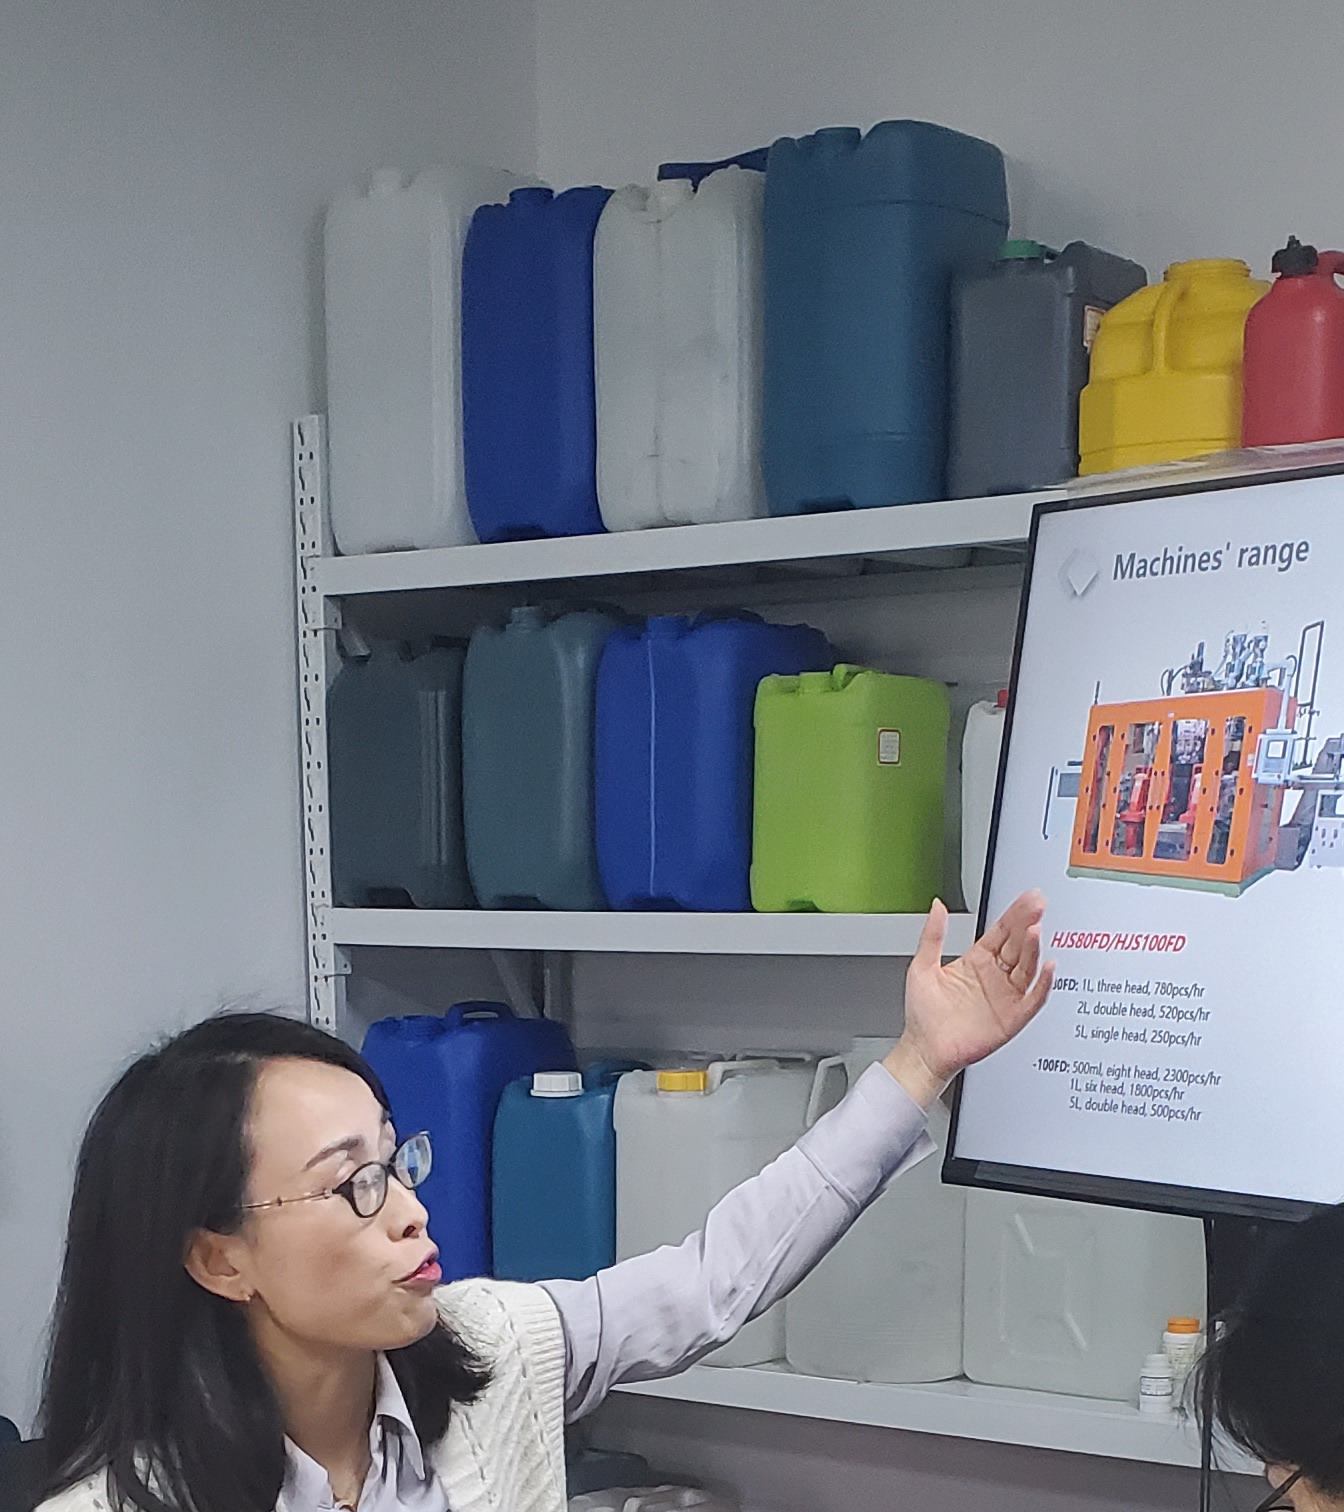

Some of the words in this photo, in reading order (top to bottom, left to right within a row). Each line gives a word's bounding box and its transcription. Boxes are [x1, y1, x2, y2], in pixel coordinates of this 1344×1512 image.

[1112, 542, 1230, 580] Machines'
[1237, 540, 1310, 572] range
[1051, 931, 1186, 952] HJS80FD/HJS100FD
[1097, 980, 1122, 994] three
[1124, 980, 1151, 996] head,
[1154, 982, 1205, 999] 780pcs/hr
[1093, 1002, 1127, 1017] double
[1129, 1003, 1156, 1020] head,
[1159, 1005, 1211, 1023] 520pcs/hr
[1091, 1027, 1119, 1043] single
[1121, 1028, 1148, 1044] head,
[1150, 1030, 1202, 1048] 250pcs/hr
[1106, 1063, 1131, 1080] eight
[1134, 1065, 1161, 1082] head,
[1163, 1068, 1221, 1087] 2300pcs/hr
[1084, 1080, 1097, 1093] six
[1100, 1081, 1125, 1096] head,
[1130, 1084, 1185, 1101] 1800pcs/hr
[1085, 1098, 1119, 1114] double
[1121, 1100, 1147, 1118] head,
[1150, 1103, 1202, 1122] 500pcs/hr
